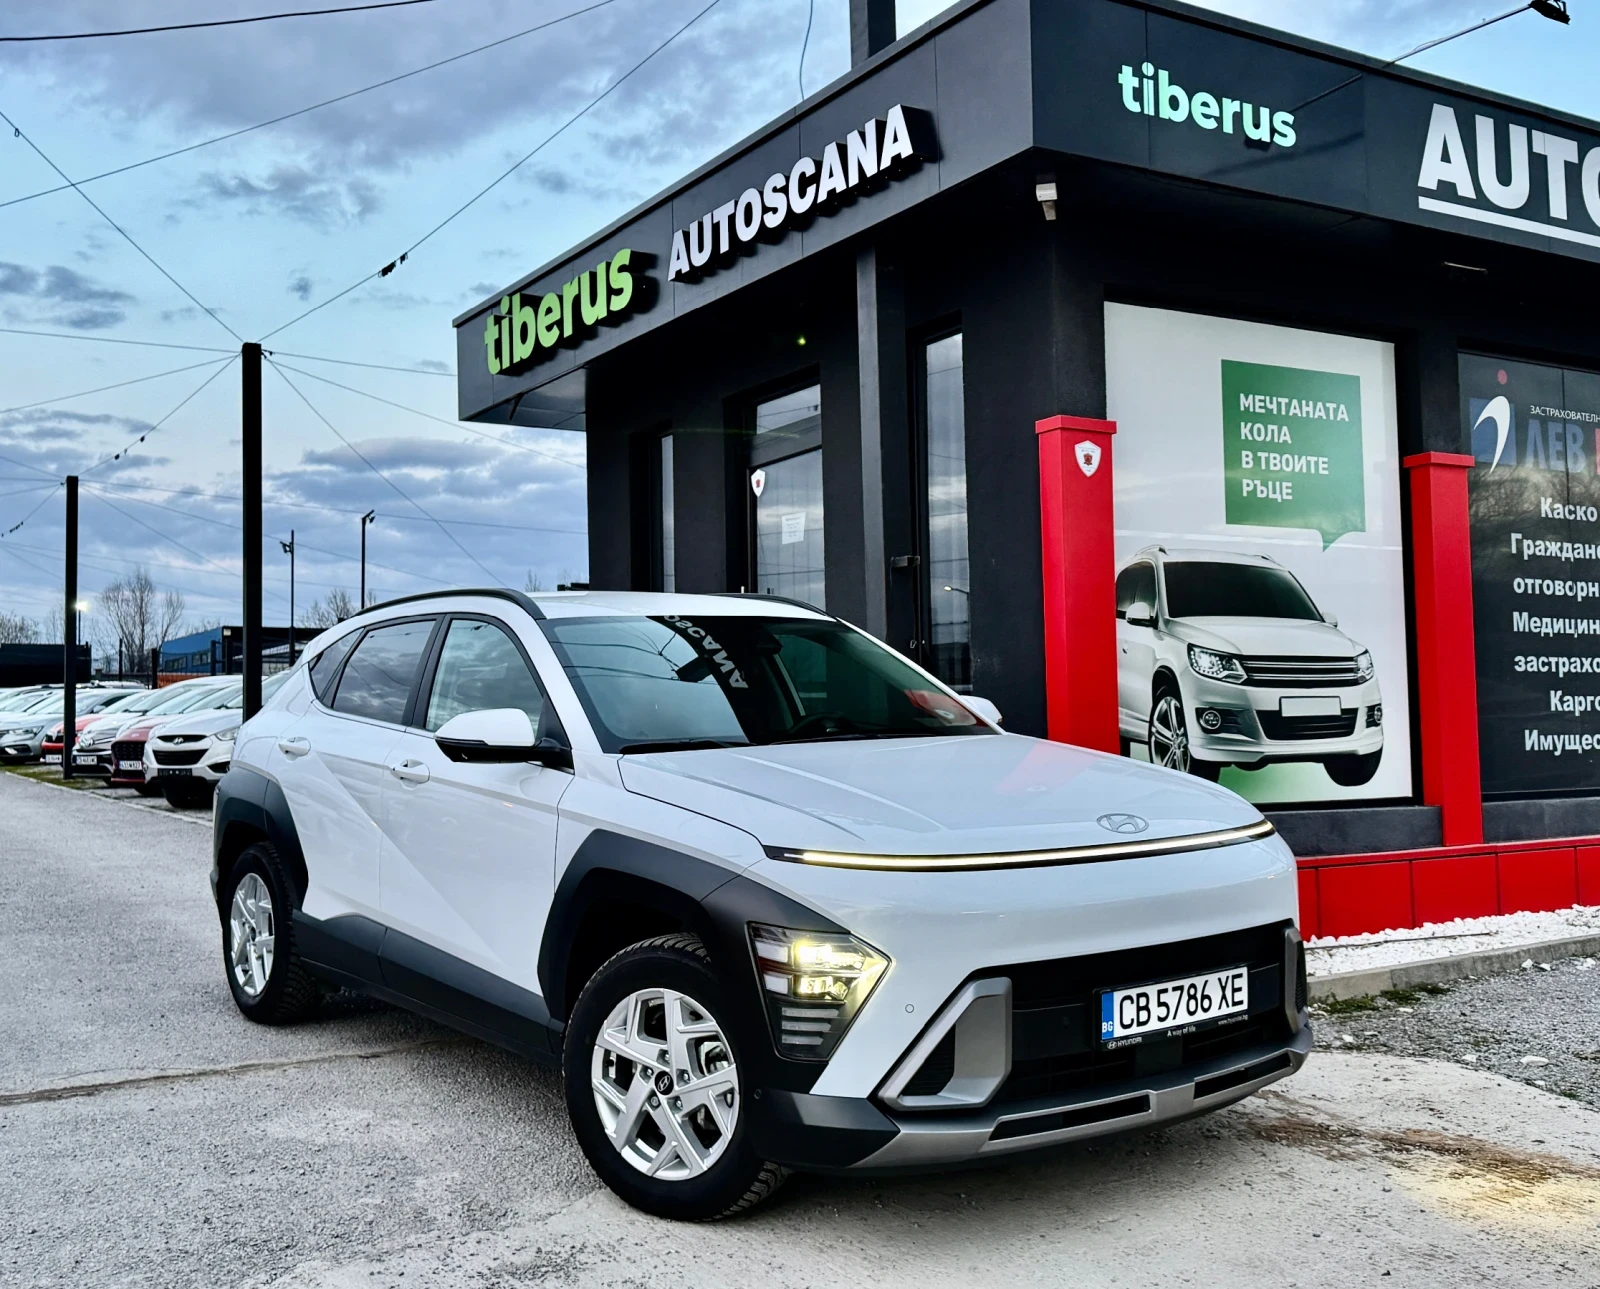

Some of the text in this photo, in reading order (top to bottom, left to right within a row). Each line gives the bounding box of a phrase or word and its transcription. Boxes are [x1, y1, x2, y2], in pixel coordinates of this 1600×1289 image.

[1118, 61, 1297, 148] tiberus
[484, 103, 913, 375] tiberus AUTOSCANA
[1239, 393, 1349, 421] МЕЧТАНАТА
[1240, 422, 1292, 444] КОЛА
[1526, 419, 1586, 474] ЛЕВ
[1241, 450, 1329, 475] В ТВОИТЕ
[1242, 479, 1293, 502] РЪЦЕ
[1541, 497, 1598, 522] Каско
[1513, 577, 1600, 602] отговорн
[1513, 611, 1600, 637] Медицин
[1119, 973, 1244, 1030] CB 5786 XE
[1102, 1021, 1114, 1033] BG
